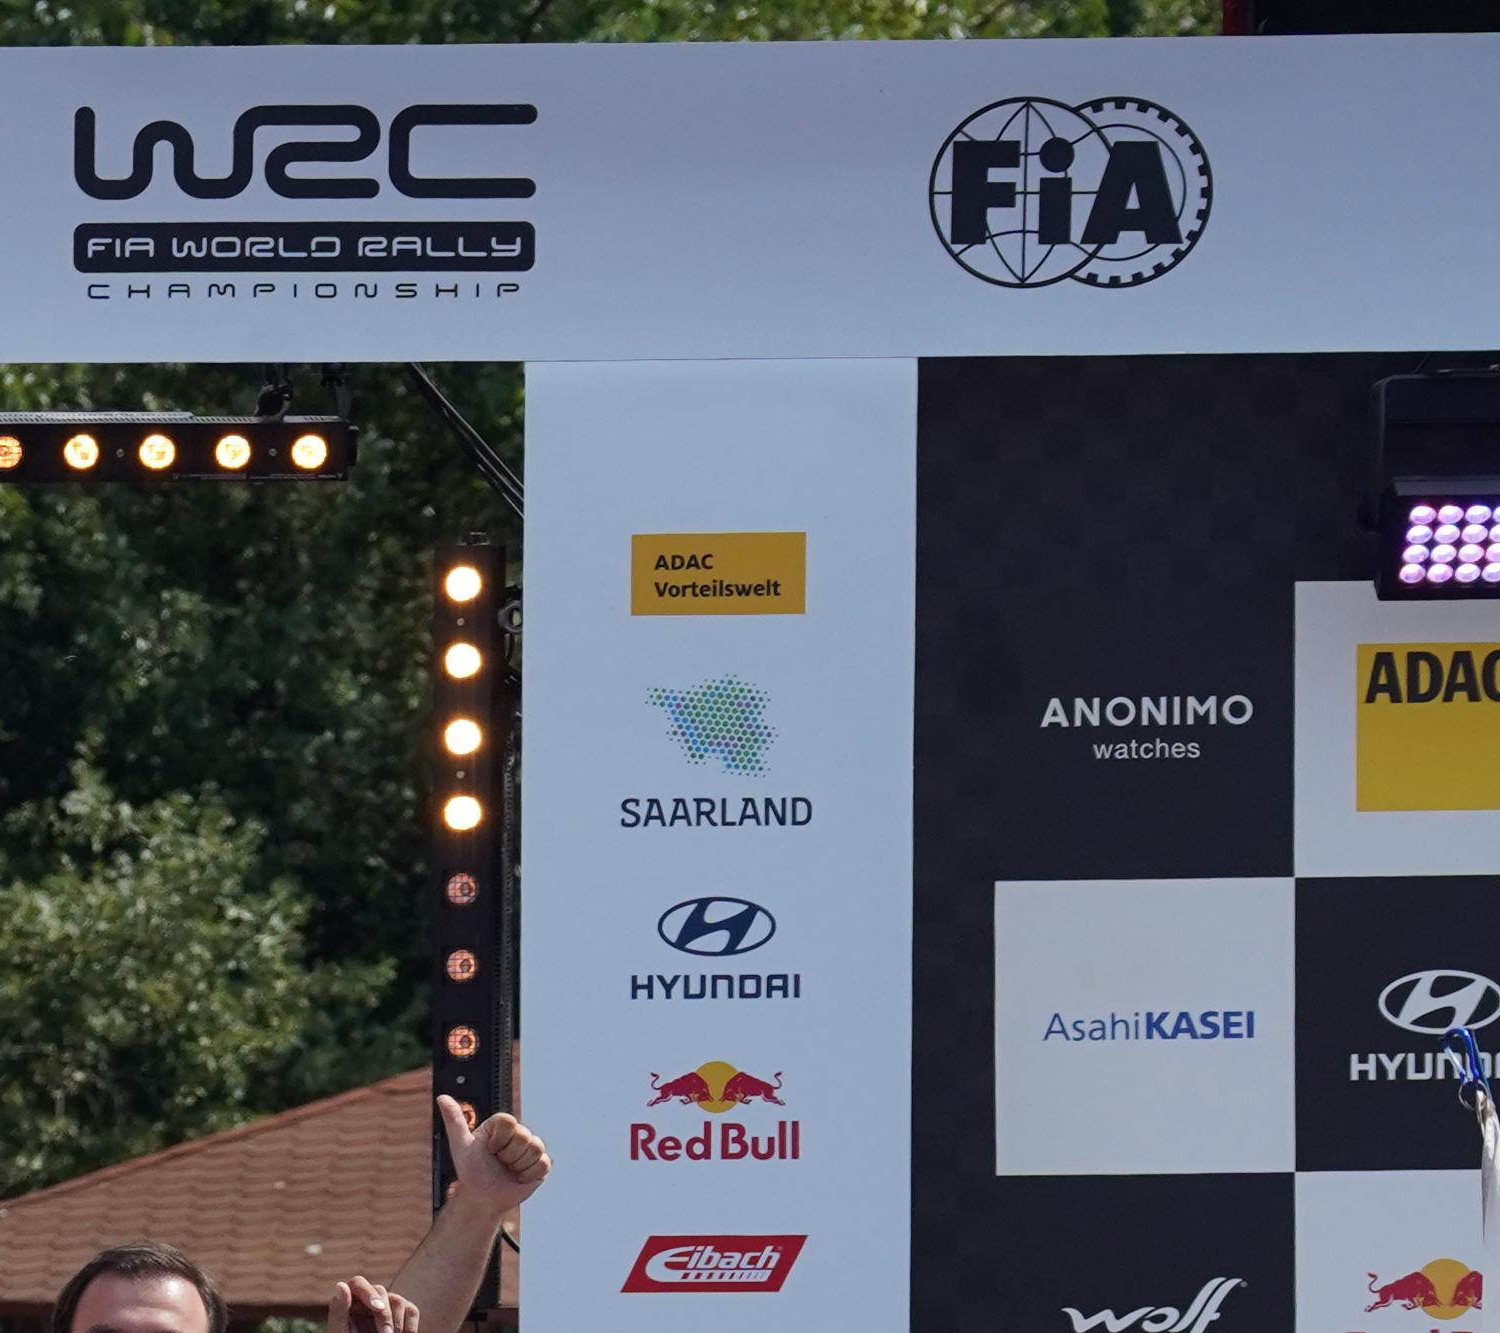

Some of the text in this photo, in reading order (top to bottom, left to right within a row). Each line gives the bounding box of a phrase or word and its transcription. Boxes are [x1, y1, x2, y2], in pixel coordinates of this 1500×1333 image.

[86, 236, 521, 259] FIA WORLD RALLY
[86, 282, 521, 300] CHAMPIONSHIP
[654, 554, 714, 571] ADAC
[654, 578, 782, 600] Vorteilswelt
[1040, 694, 1254, 728] ANONIMO
[1092, 738, 1202, 760] watches
[619, 796, 813, 829] SAARLAND
[630, 973, 802, 1001] HYUNDAI
[1042, 1010, 1256, 1042] AsahiKASEI
[644, 1243, 781, 1281] Eibach
